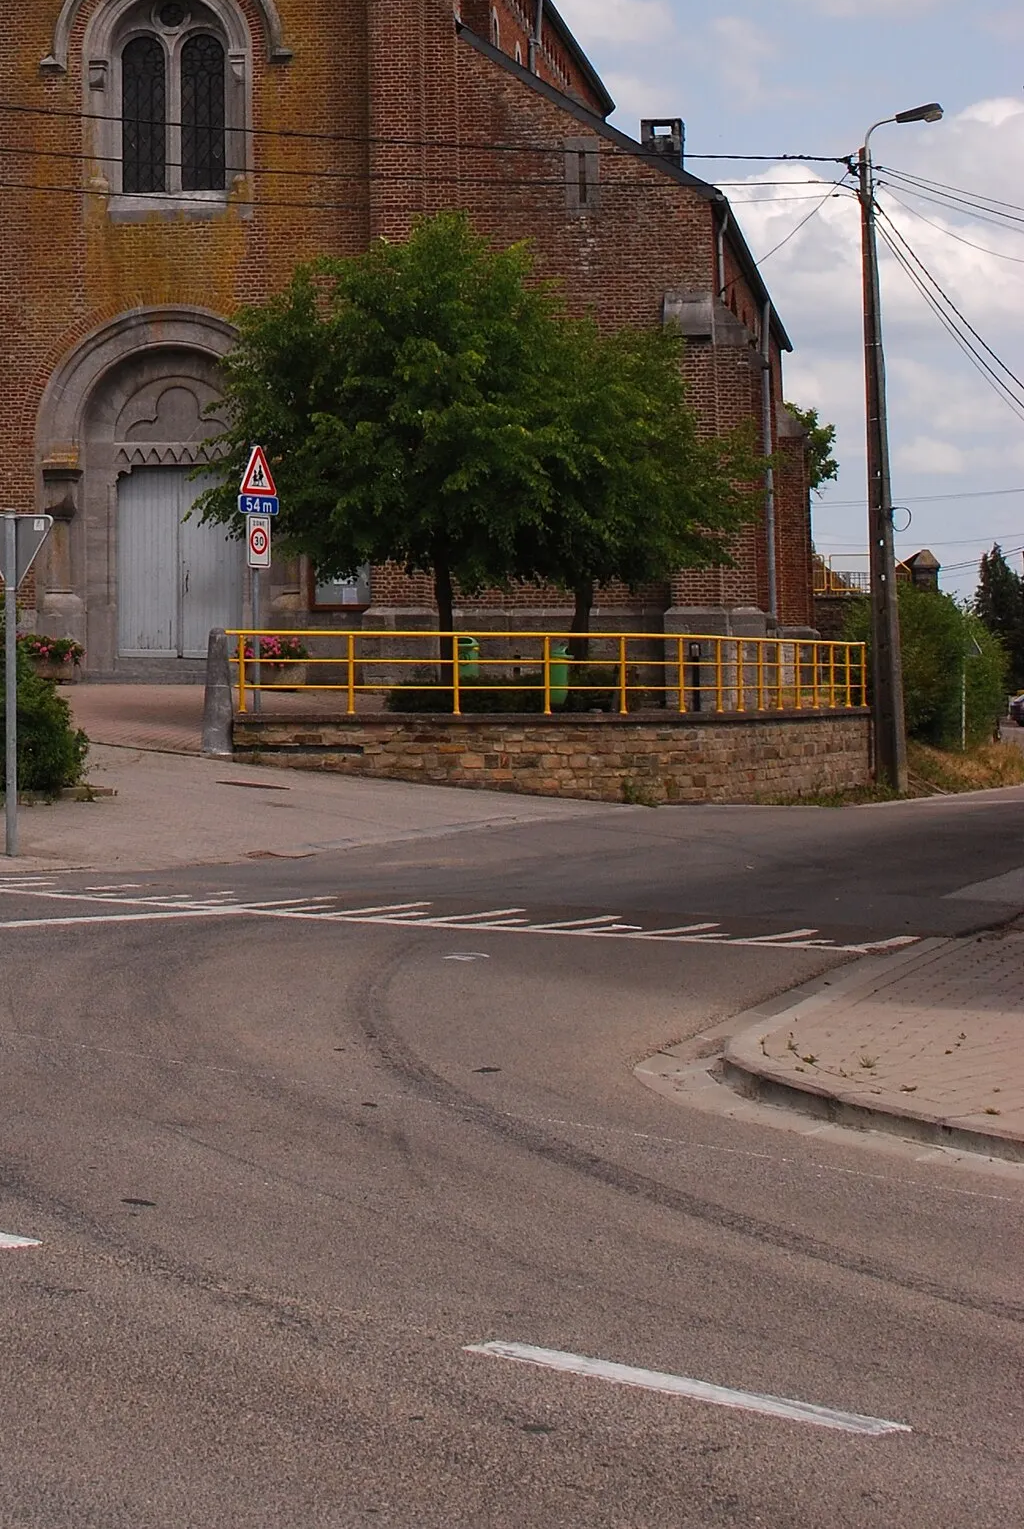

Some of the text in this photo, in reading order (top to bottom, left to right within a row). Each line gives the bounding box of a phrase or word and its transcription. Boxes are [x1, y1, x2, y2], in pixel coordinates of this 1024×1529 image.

[246, 497, 272, 513] 54 m
[254, 536, 264, 546] 30
